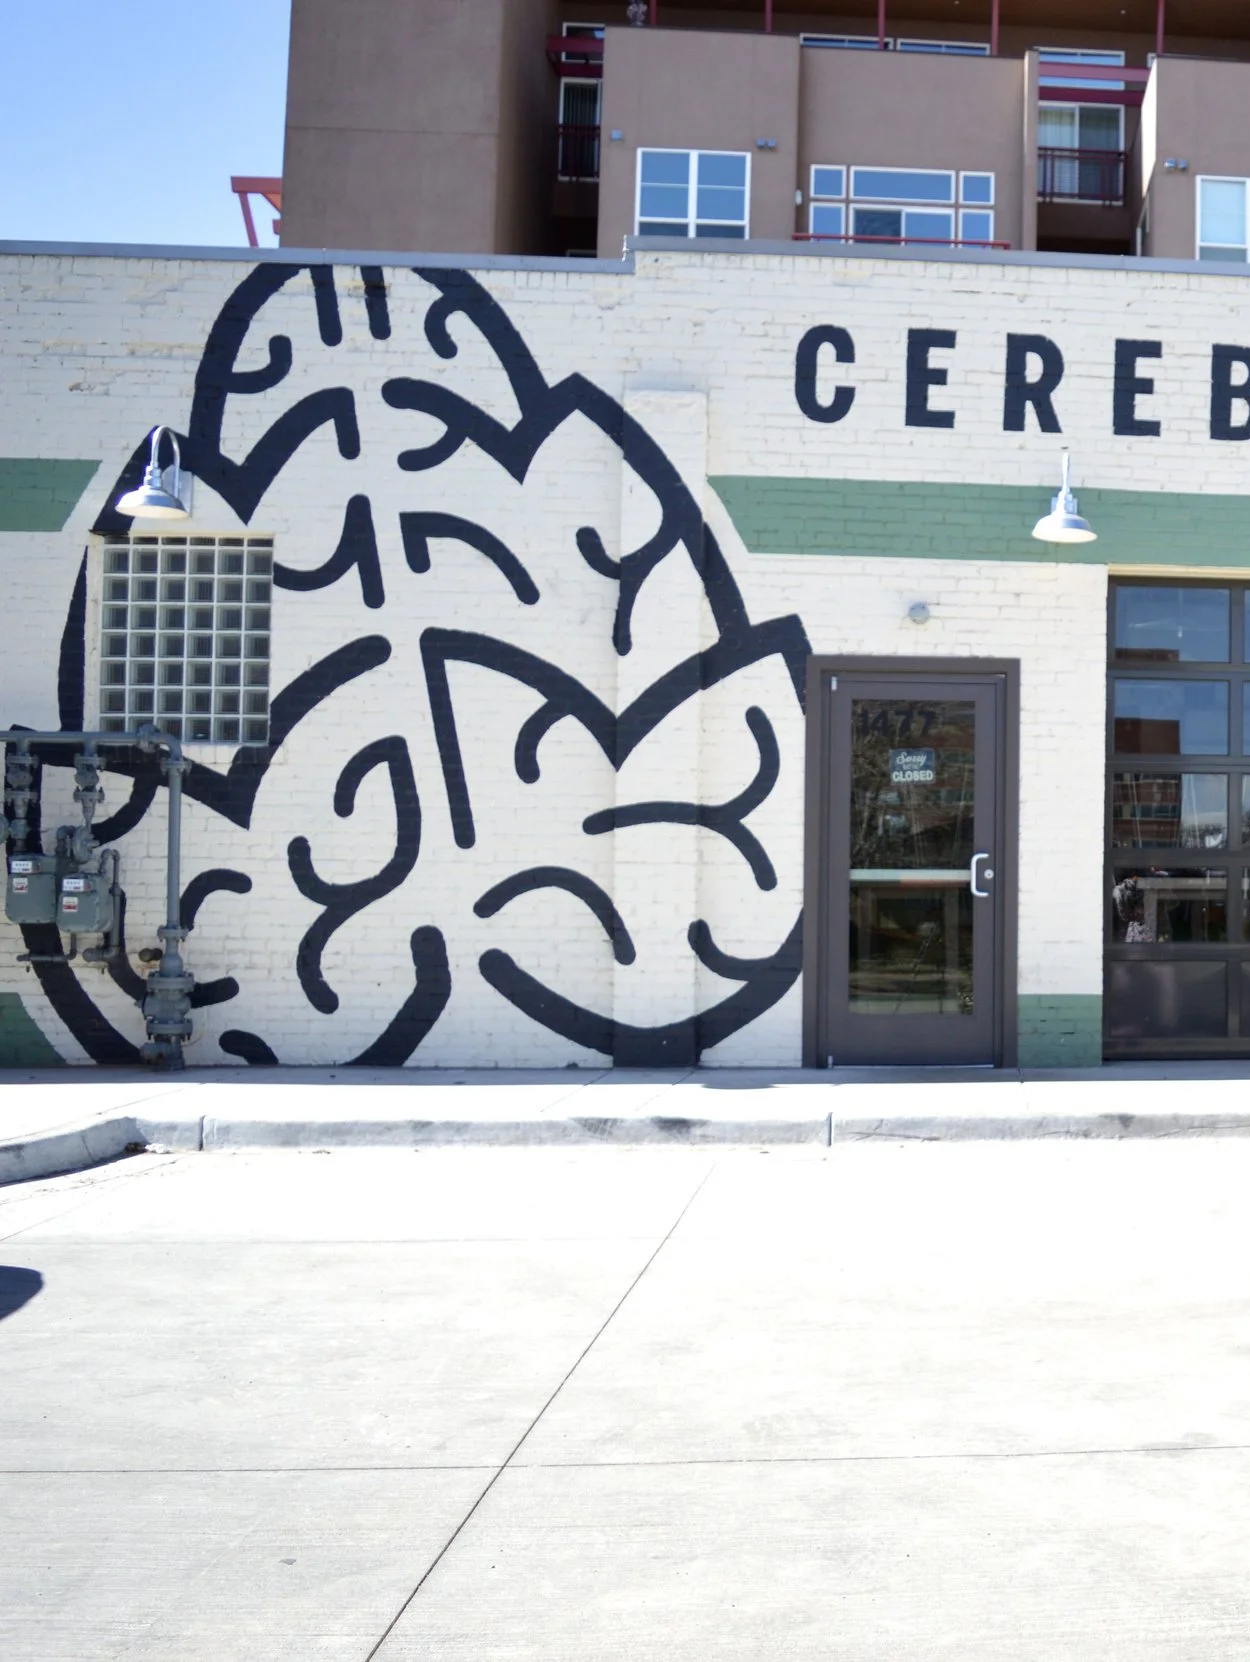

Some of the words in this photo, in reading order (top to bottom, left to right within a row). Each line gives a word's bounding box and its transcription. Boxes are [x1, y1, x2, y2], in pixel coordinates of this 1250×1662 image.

[861, 709, 936, 738] 1477
[896, 751, 927, 767] Sorry
[892, 770, 934, 782] CLOSED
